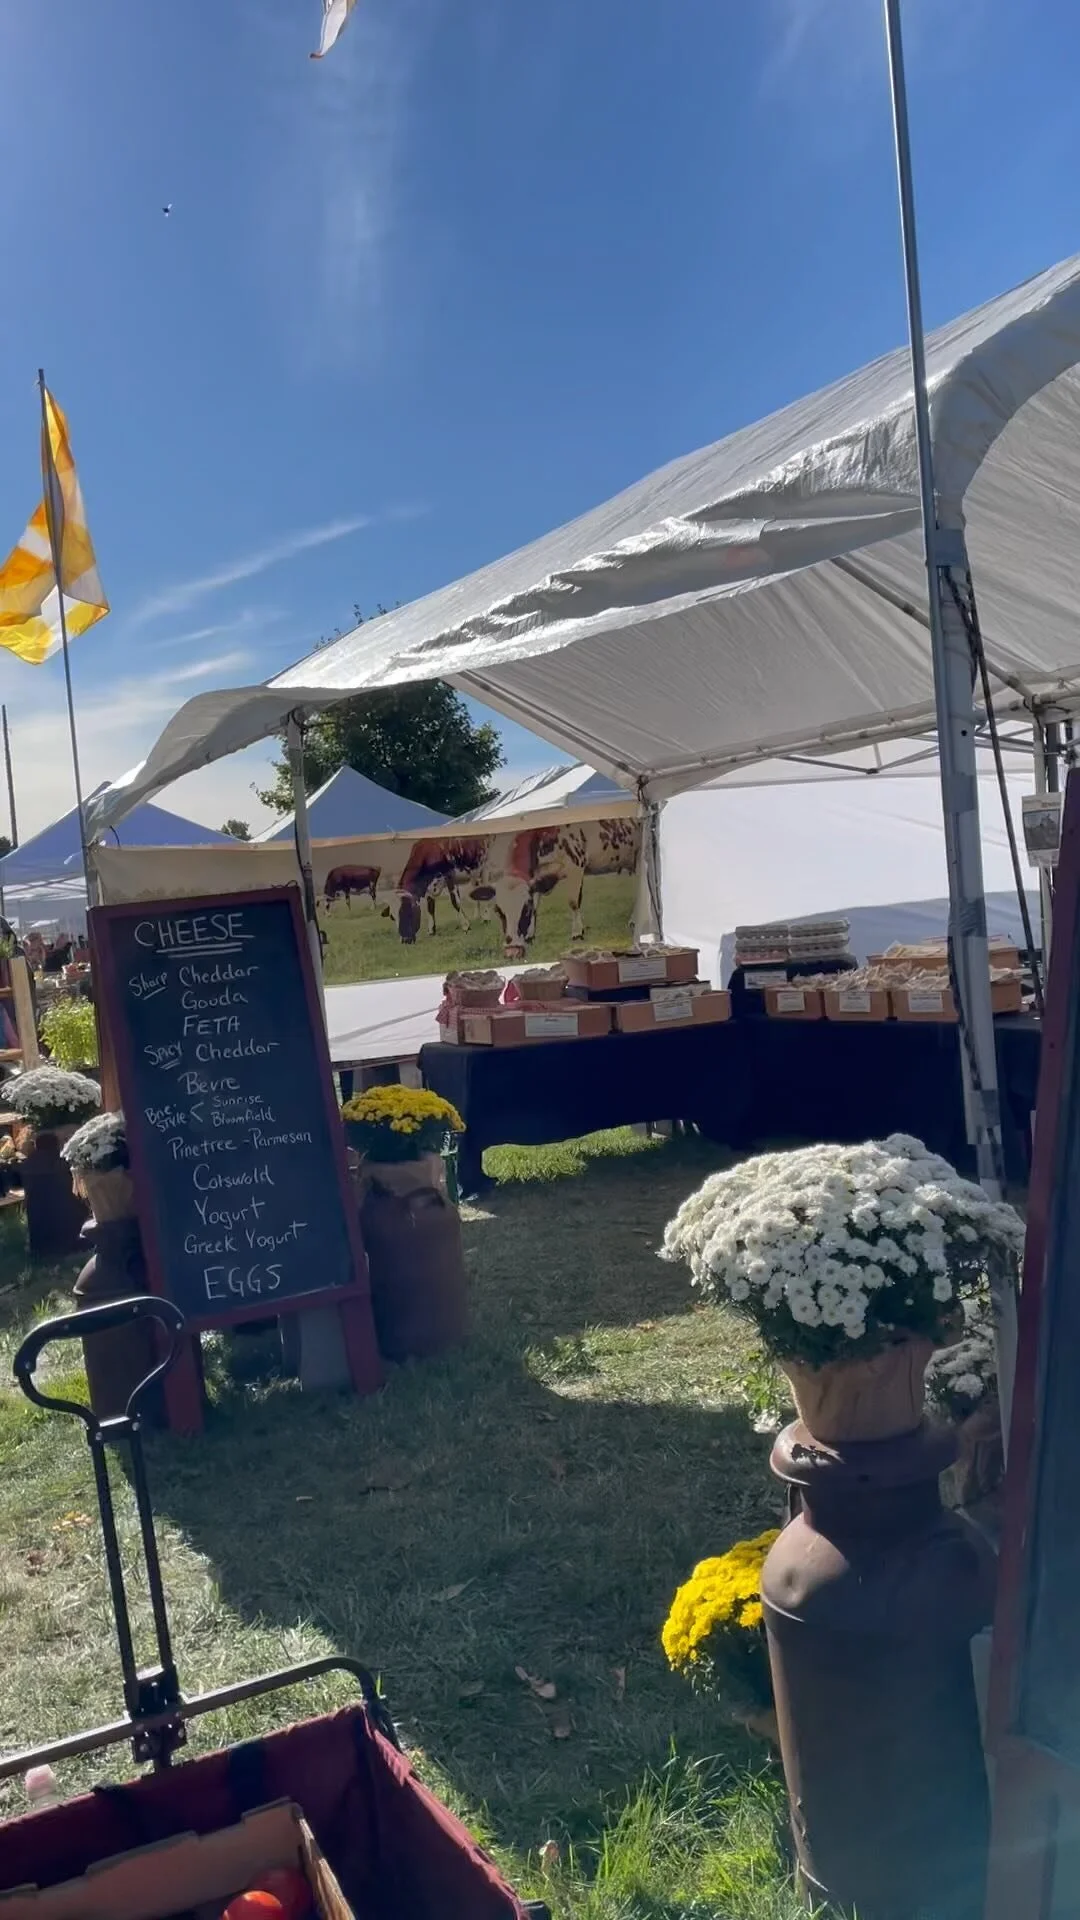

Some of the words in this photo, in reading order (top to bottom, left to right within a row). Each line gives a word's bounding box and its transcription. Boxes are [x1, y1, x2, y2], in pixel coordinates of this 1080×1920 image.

[134, 912, 255, 948] CHEESE
[128, 971, 168, 997] Sharp
[179, 963, 260, 987] Cheddar
[181, 986, 249, 1010] Gouda
[183, 1015, 241, 1037] FETA
[195, 1037, 281, 1062] Cheddar
[177, 1071, 240, 1095] Bevre
[212, 1094, 264, 1107] Sunrise
[210, 1106, 276, 1127] Bloomfield
[167, 1136, 238, 1160] Pinetree
[193, 1196, 266, 1230] Yogurt
[184, 1234, 238, 1255] Greek
[245, 1220, 308, 1251] Yogurt
[203, 1264, 283, 1300] EGGS
